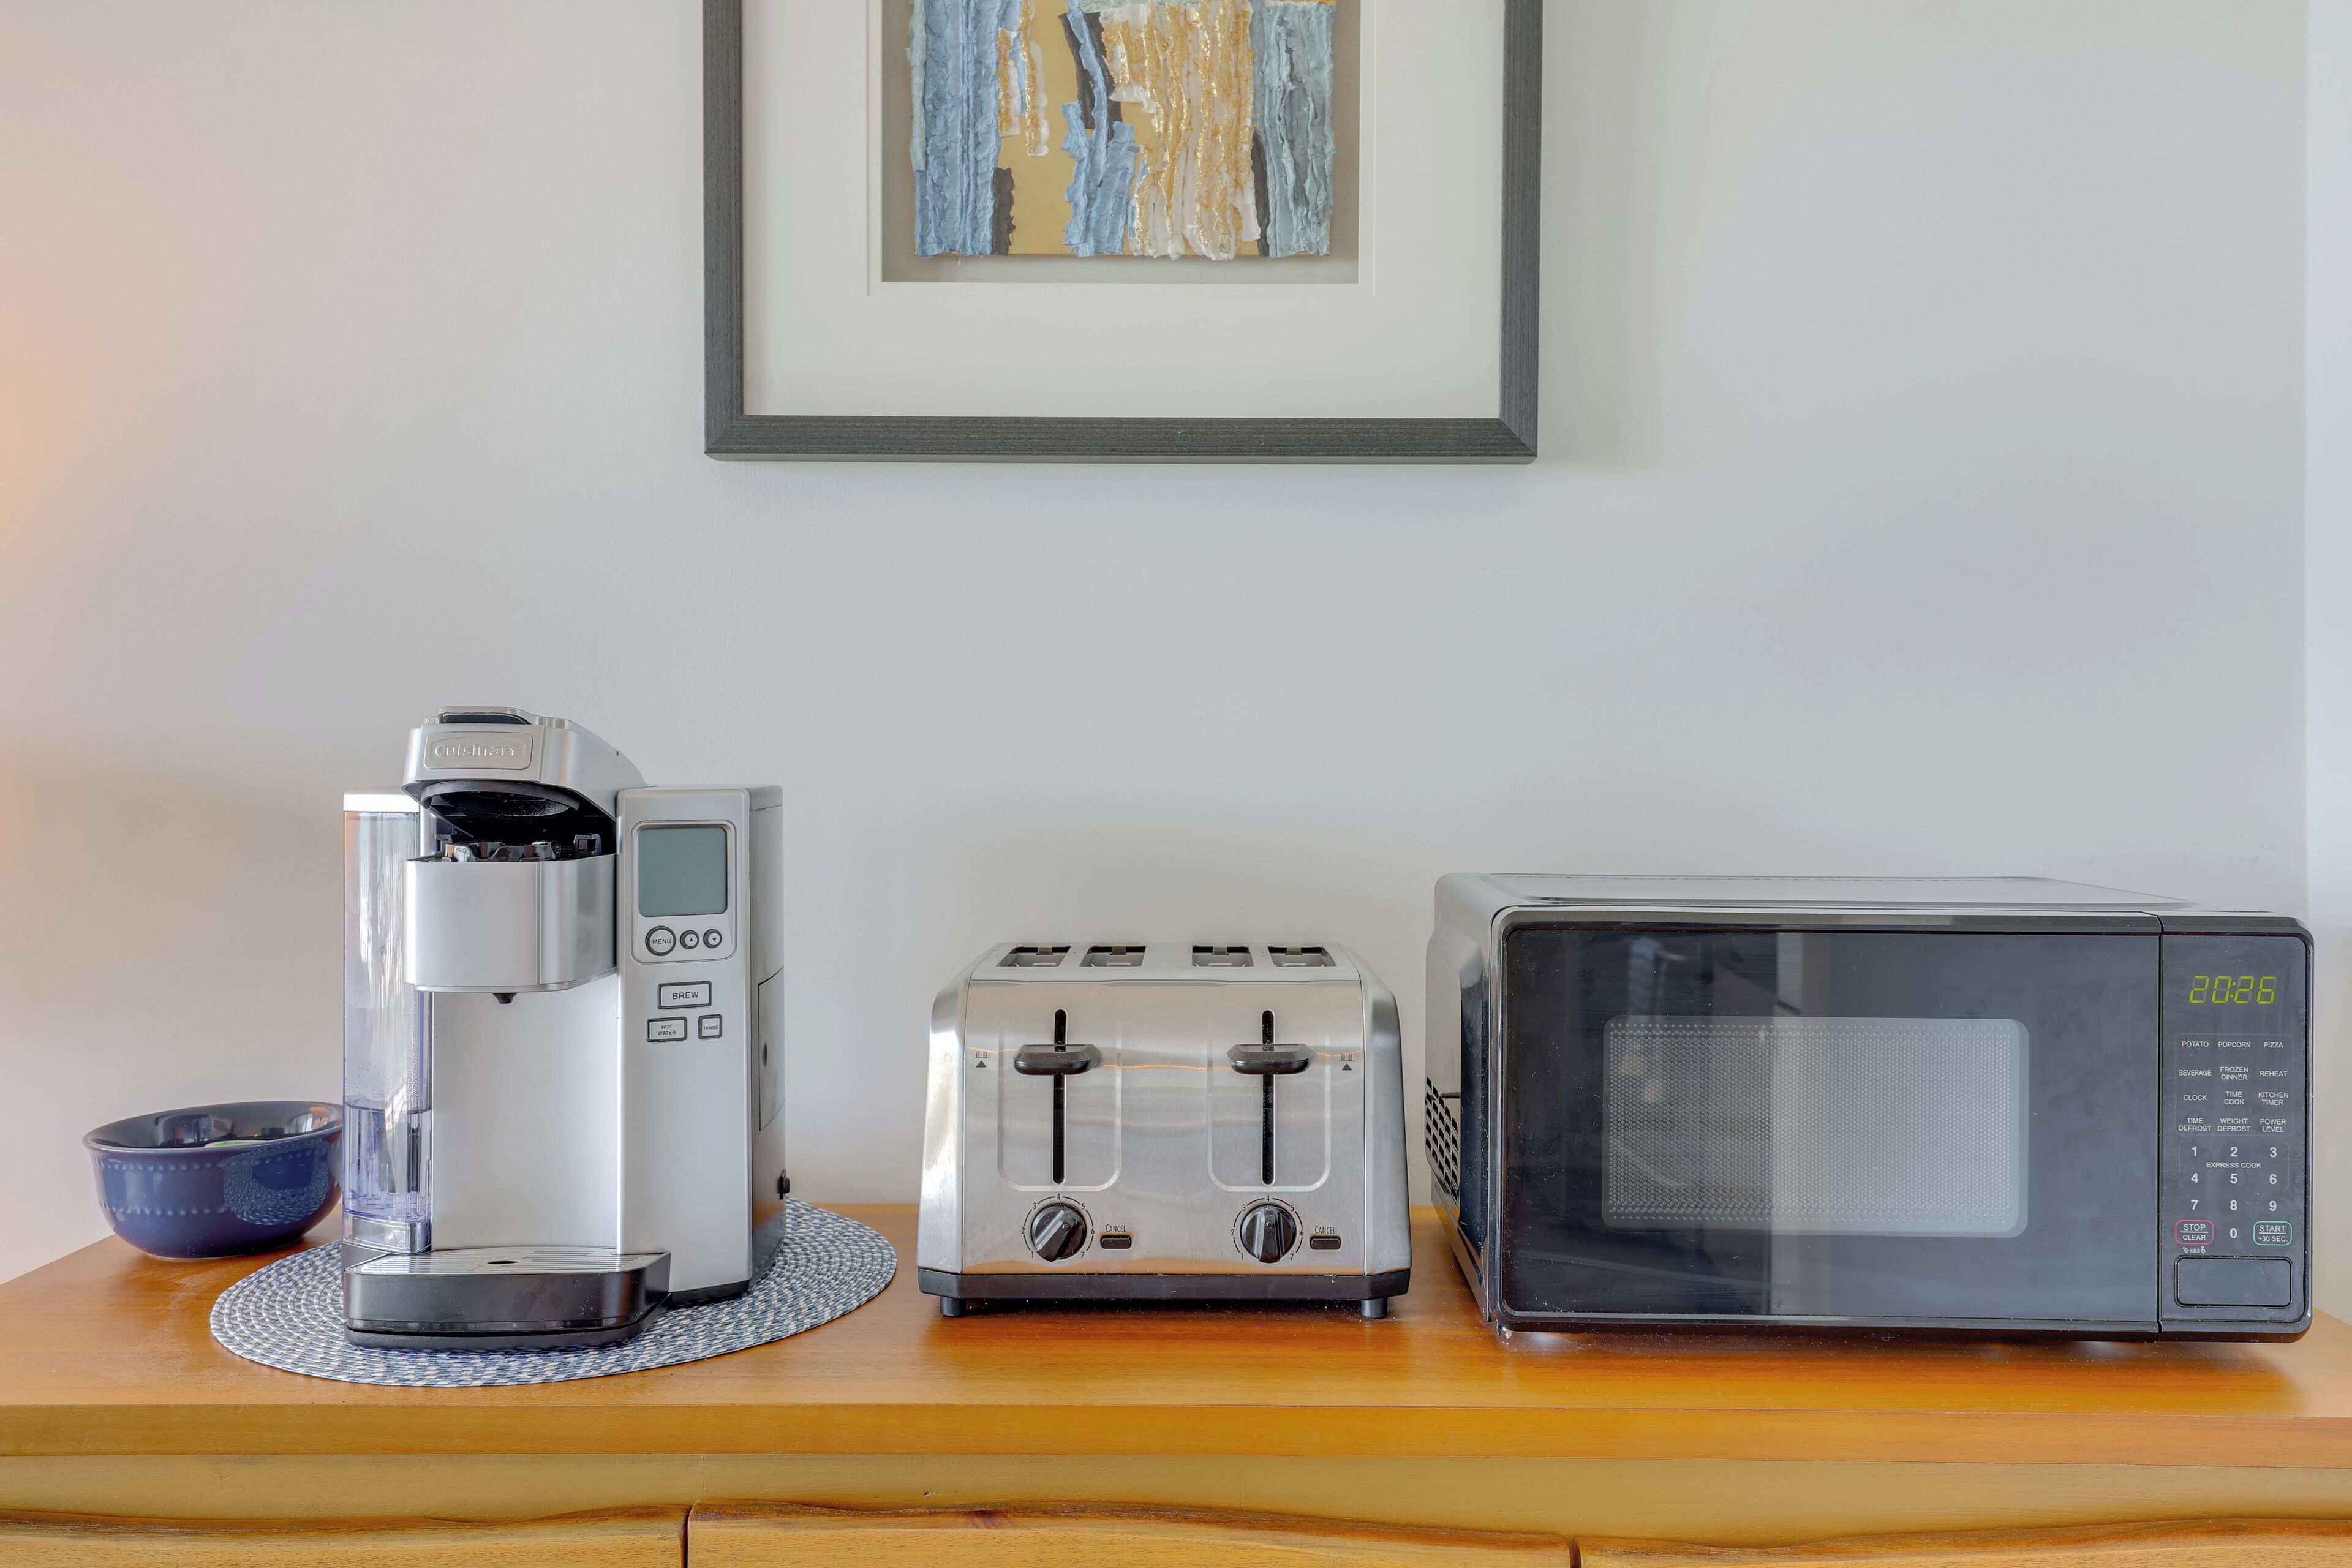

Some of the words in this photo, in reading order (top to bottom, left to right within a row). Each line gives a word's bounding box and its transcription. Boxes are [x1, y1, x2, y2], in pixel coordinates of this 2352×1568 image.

[435, 744, 519, 756] Cuisinart
[672, 991, 699, 1000] BREW
[2188, 975, 2277, 1005] 20:26
[2192, 1146, 2197, 1156] 1
[2230, 1147, 2238, 1157] 2
[2269, 1147, 2277, 1158] 3
[2191, 1173, 2199, 1183] 4
[2230, 1174, 2238, 1184] 5
[2269, 1174, 2277, 1185] 6
[2190, 1199, 2199, 1210] 7
[2230, 1200, 2237, 1211] 8
[2269, 1200, 2277, 1212] 9
[2230, 1228, 2237, 1238] 0
